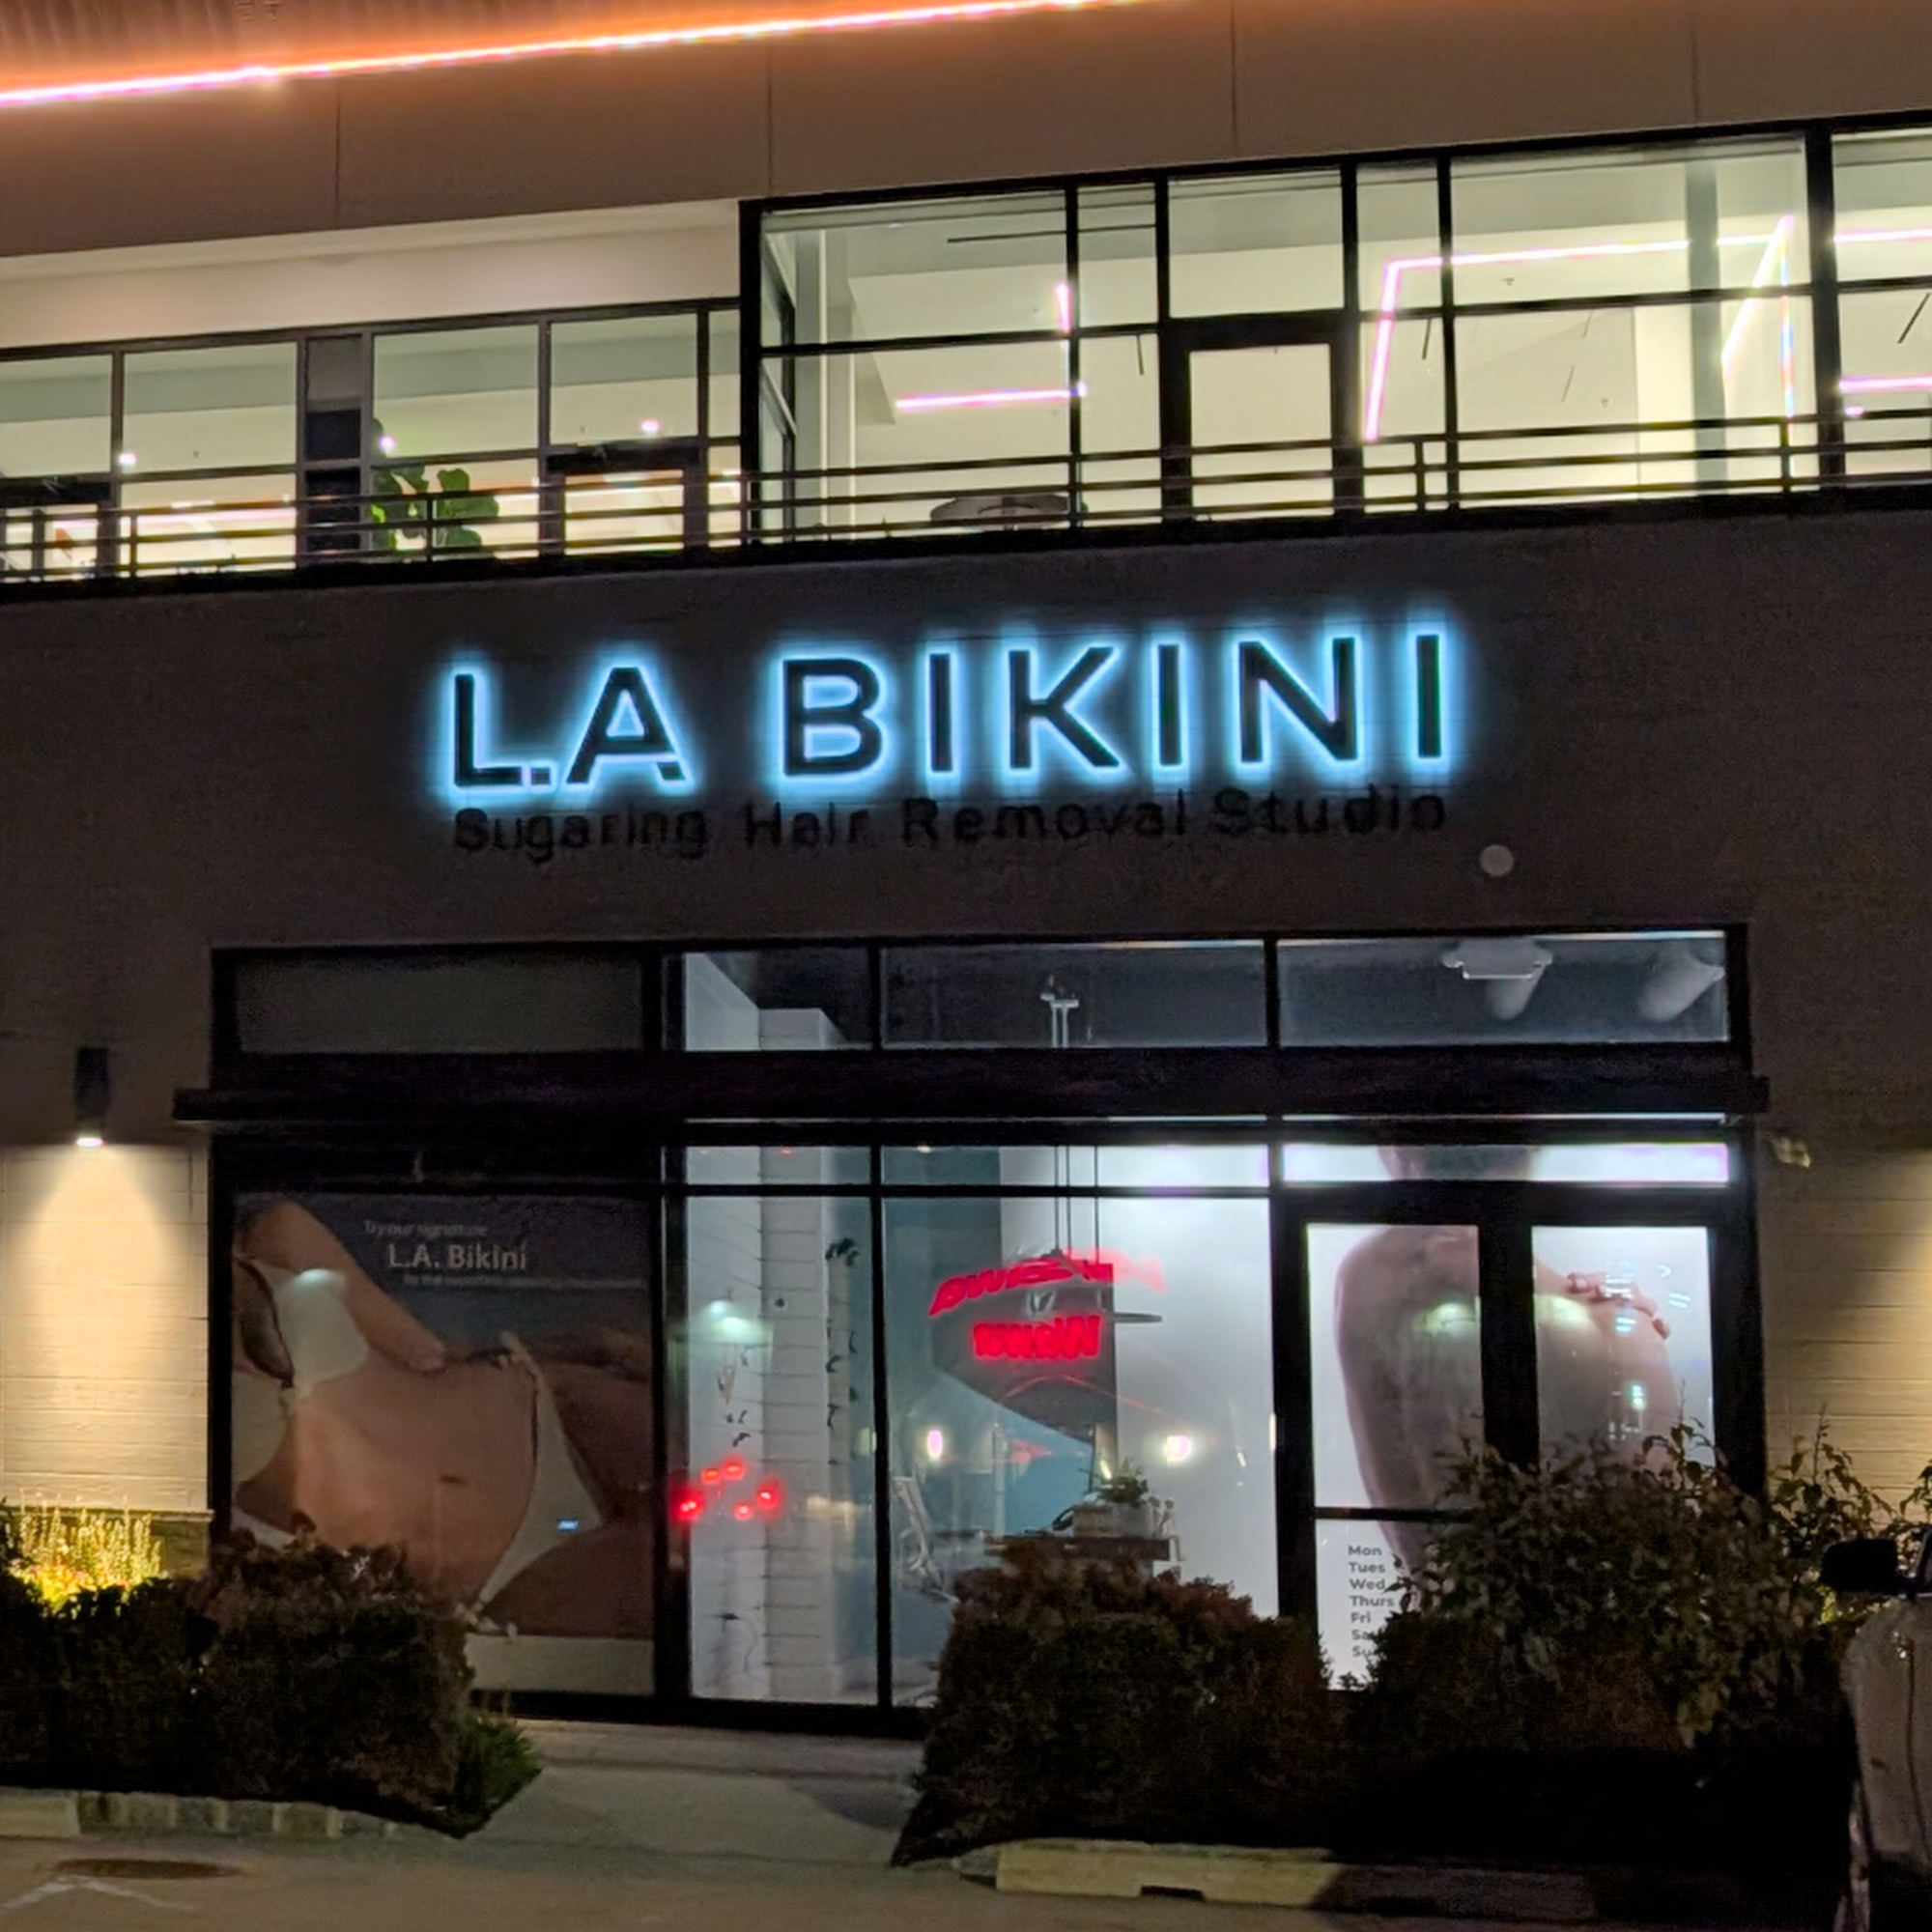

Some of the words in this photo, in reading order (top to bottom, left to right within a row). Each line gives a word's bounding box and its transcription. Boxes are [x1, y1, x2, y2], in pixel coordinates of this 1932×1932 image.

[783, 634, 1442, 778] BIKINI
[454, 801, 707, 863] Sugaring
[745, 801, 869, 847] Hair
[903, 787, 1185, 844] Removal
[1213, 784, 1445, 836] Studio
[388, 1242, 440, 1268] L.A.
[448, 1239, 527, 1270] Bikini
[1348, 1545, 1382, 1556] Mon
[1349, 1561, 1386, 1573] Tues
[1350, 1578, 1386, 1590] Wed
[1350, 1595, 1395, 1607] Thurs
[1350, 1611, 1372, 1624] Fri
[1351, 1629, 1378, 1641] Sa
